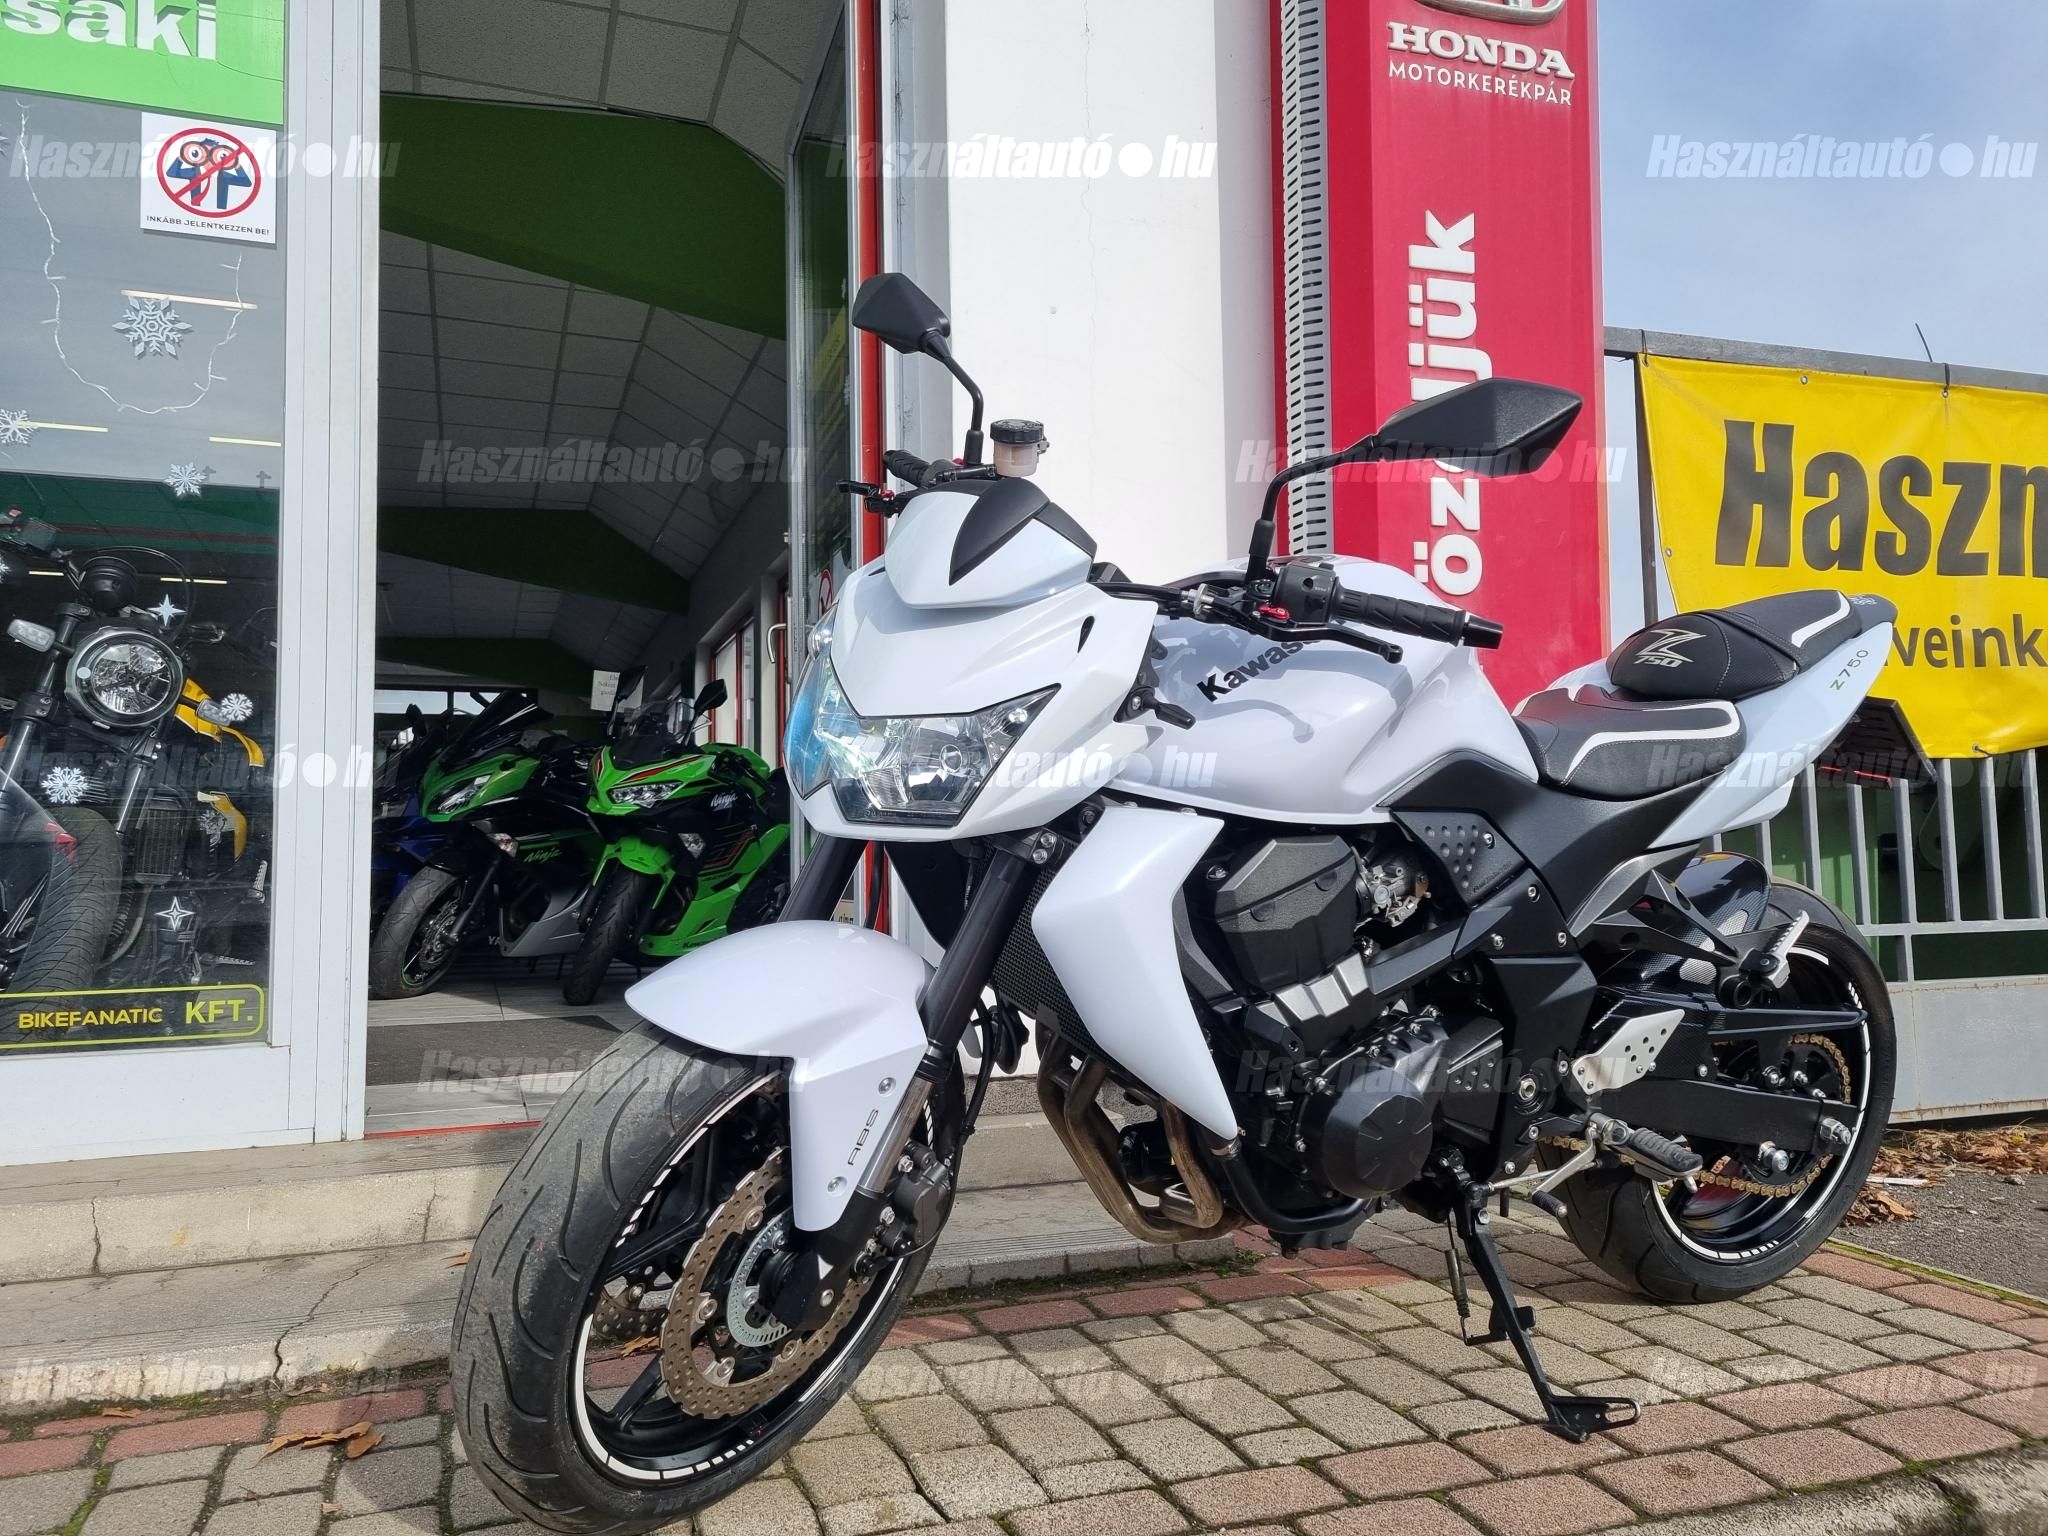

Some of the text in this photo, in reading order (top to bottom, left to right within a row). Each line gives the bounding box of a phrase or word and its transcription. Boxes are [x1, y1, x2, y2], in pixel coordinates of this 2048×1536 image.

[1388, 21, 1575, 79] HONDA
[1389, 60, 1572, 106] MOTORKERÉKPÁR
[146, 214, 182, 225] INKÁBB
[183, 219, 253, 233] JELENTKEZZEN
[1829, 649, 1869, 691] Z750
[710, 790, 738, 809] Ninja
[523, 847, 562, 864] Ninja
[18, 999, 254, 1029] BIKEFANATIC KFT.
